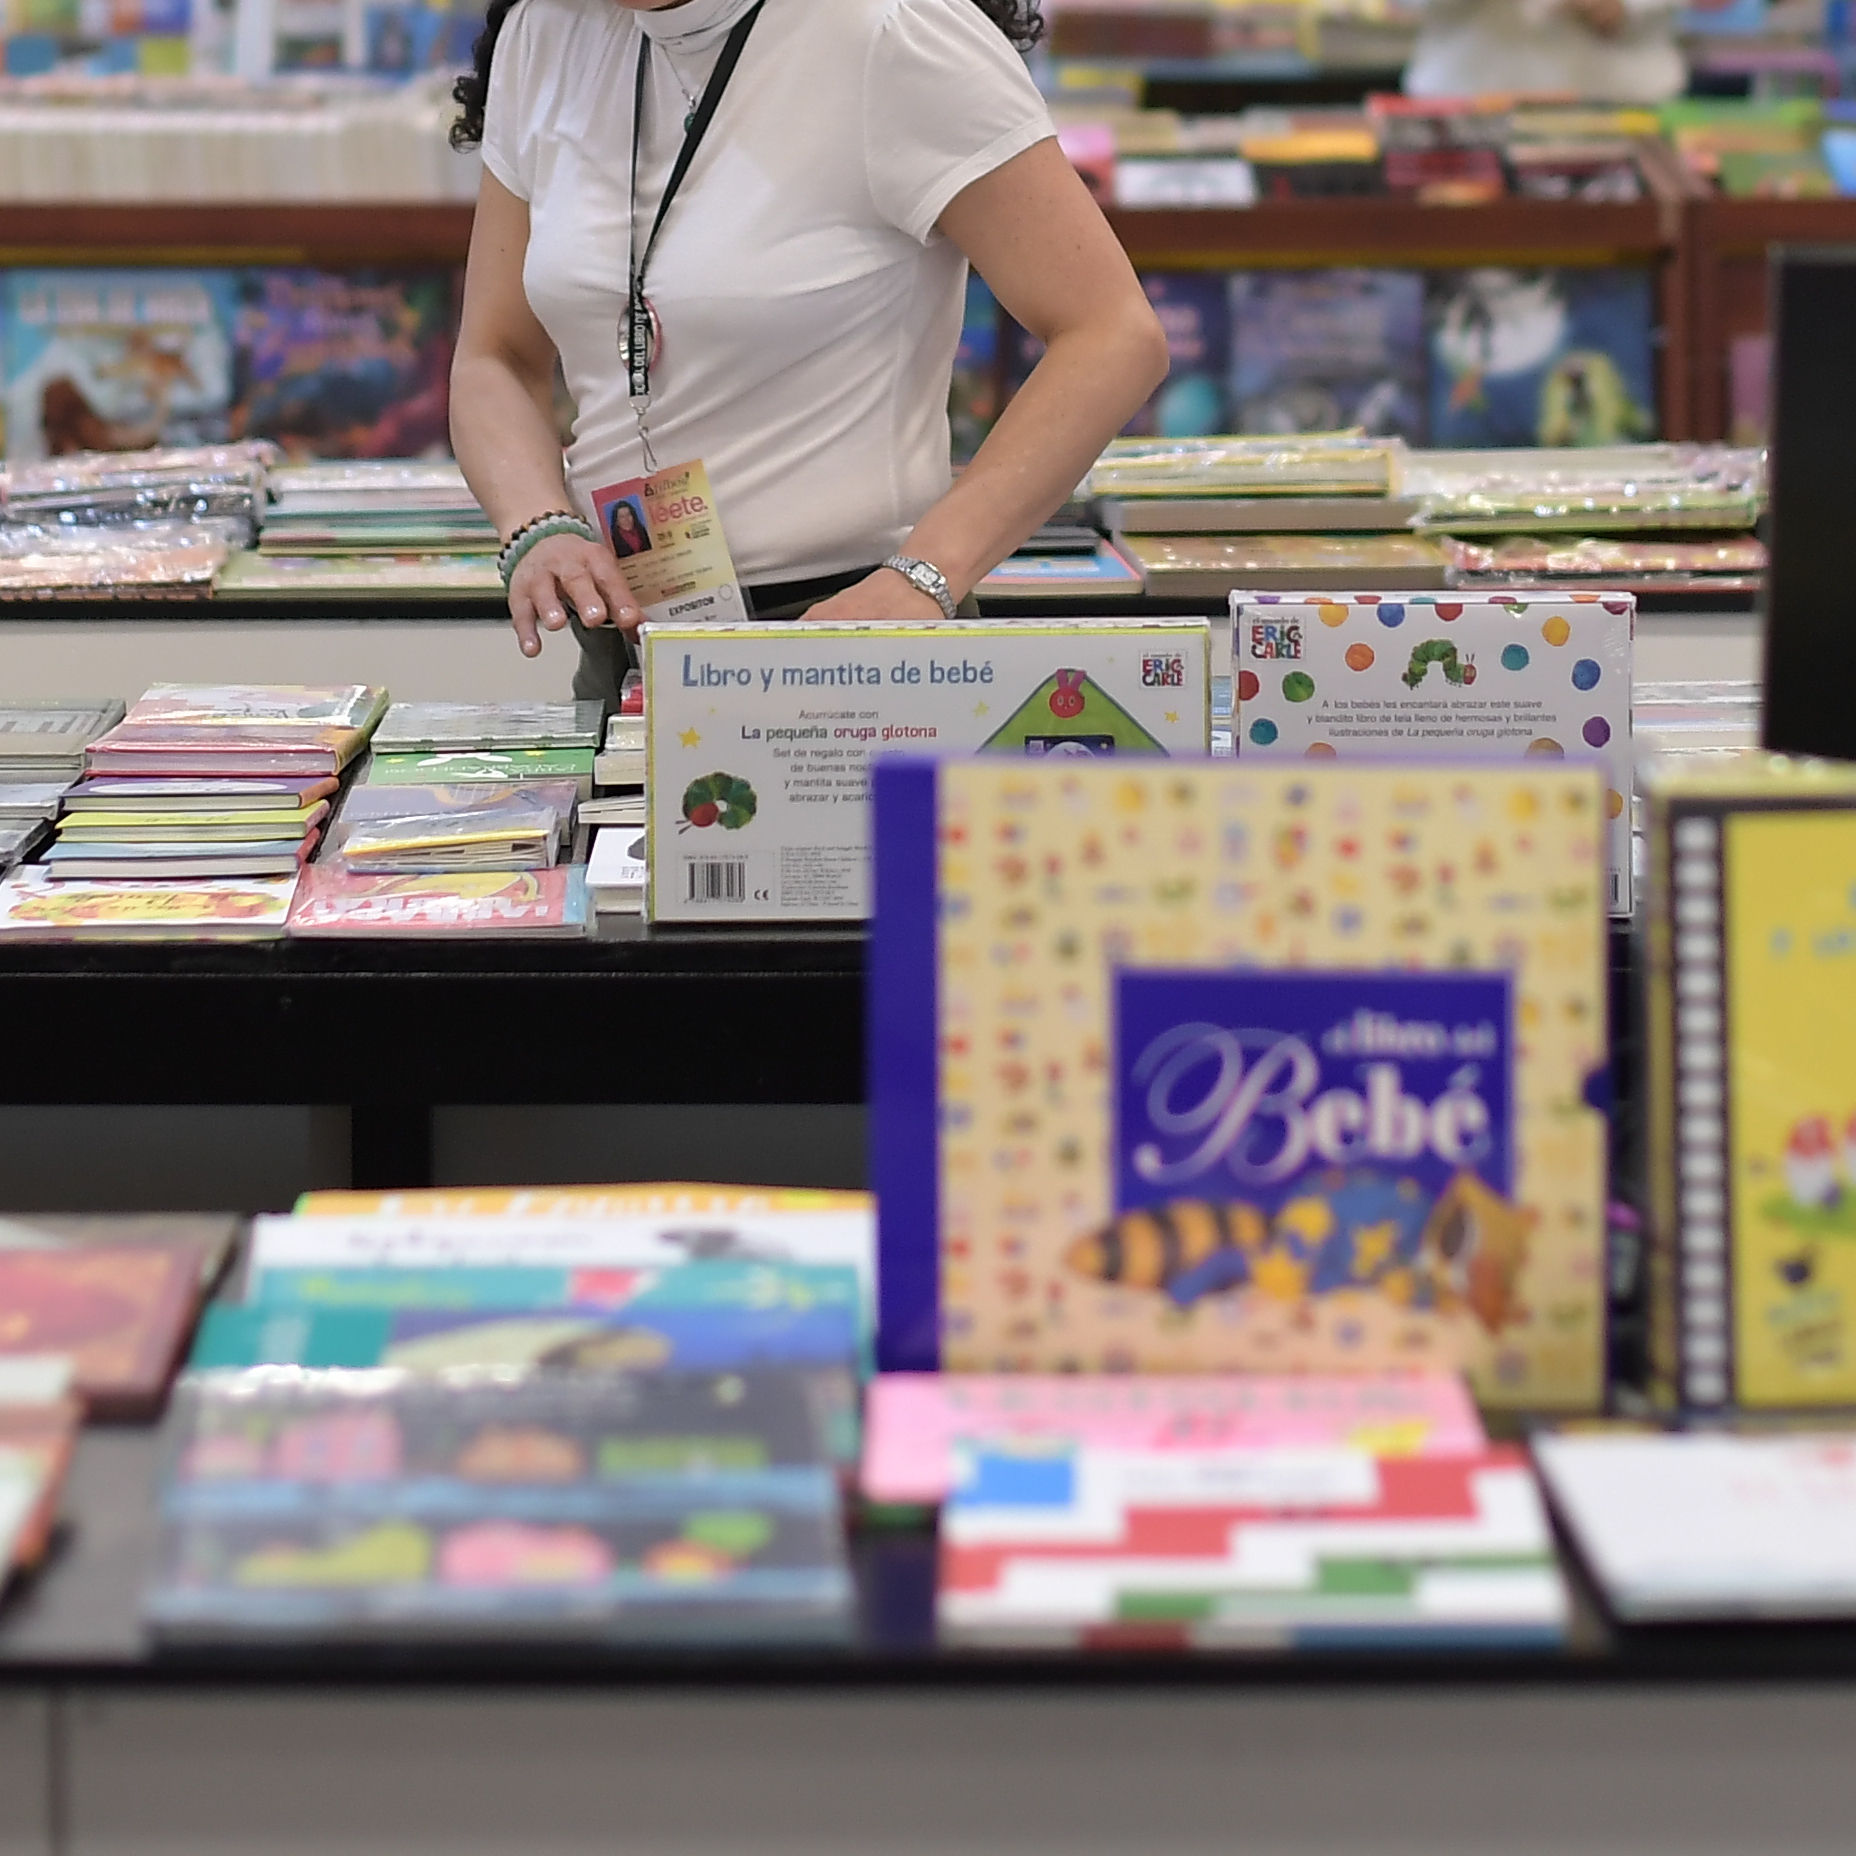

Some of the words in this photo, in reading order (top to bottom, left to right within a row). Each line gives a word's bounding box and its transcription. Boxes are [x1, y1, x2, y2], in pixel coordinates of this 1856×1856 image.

[667, 595, 716, 617] EXPOSITOR
[681, 653, 752, 688] Libro
[759, 666, 774, 692] y
[780, 661, 883, 687] mantita
[890, 659, 922, 685] de
[929, 659, 995, 685] bebé
[1322, 700, 1329, 709] A
[1334, 700, 1349, 709] los
[1383, 700, 1397, 709] les
[1451, 700, 1487, 709] abrazar
[1490, 701, 1511, 709] este
[1513, 701, 1542, 709] suave
[858, 711, 879, 720] con
[1307, 716, 1313, 724] y
[1356, 714, 1377, 723] libro
[1379, 714, 1391, 723] de
[1440, 714, 1452, 723] de
[1455, 714, 1503, 723] hermosas
[1506, 716, 1512, 725] y
[1513, 714, 1557, 723] brillantes
[740, 725, 761, 740] La
[765, 725, 828, 742] pequeña
[833, 726, 877, 741] oruga
[881, 724, 937, 743] glotona
[1328, 727, 1389, 737] ilustraciones
[1391, 727, 1404, 737] de
[1407, 727, 1419, 737] La
[1466, 729, 1494, 739] oruga
[773, 748, 791, 758] Set
[793, 748, 807, 758] de
[809, 748, 844, 760] regalo
[846, 749, 864, 758] con
[790, 762, 803, 772] de
[806, 762, 846, 772] buenas
[784, 780, 790, 790] y
[793, 778, 832, 788] mantita
[788, 793, 829, 802] abrazar
[1131, 1021, 1492, 1187] Bebé
